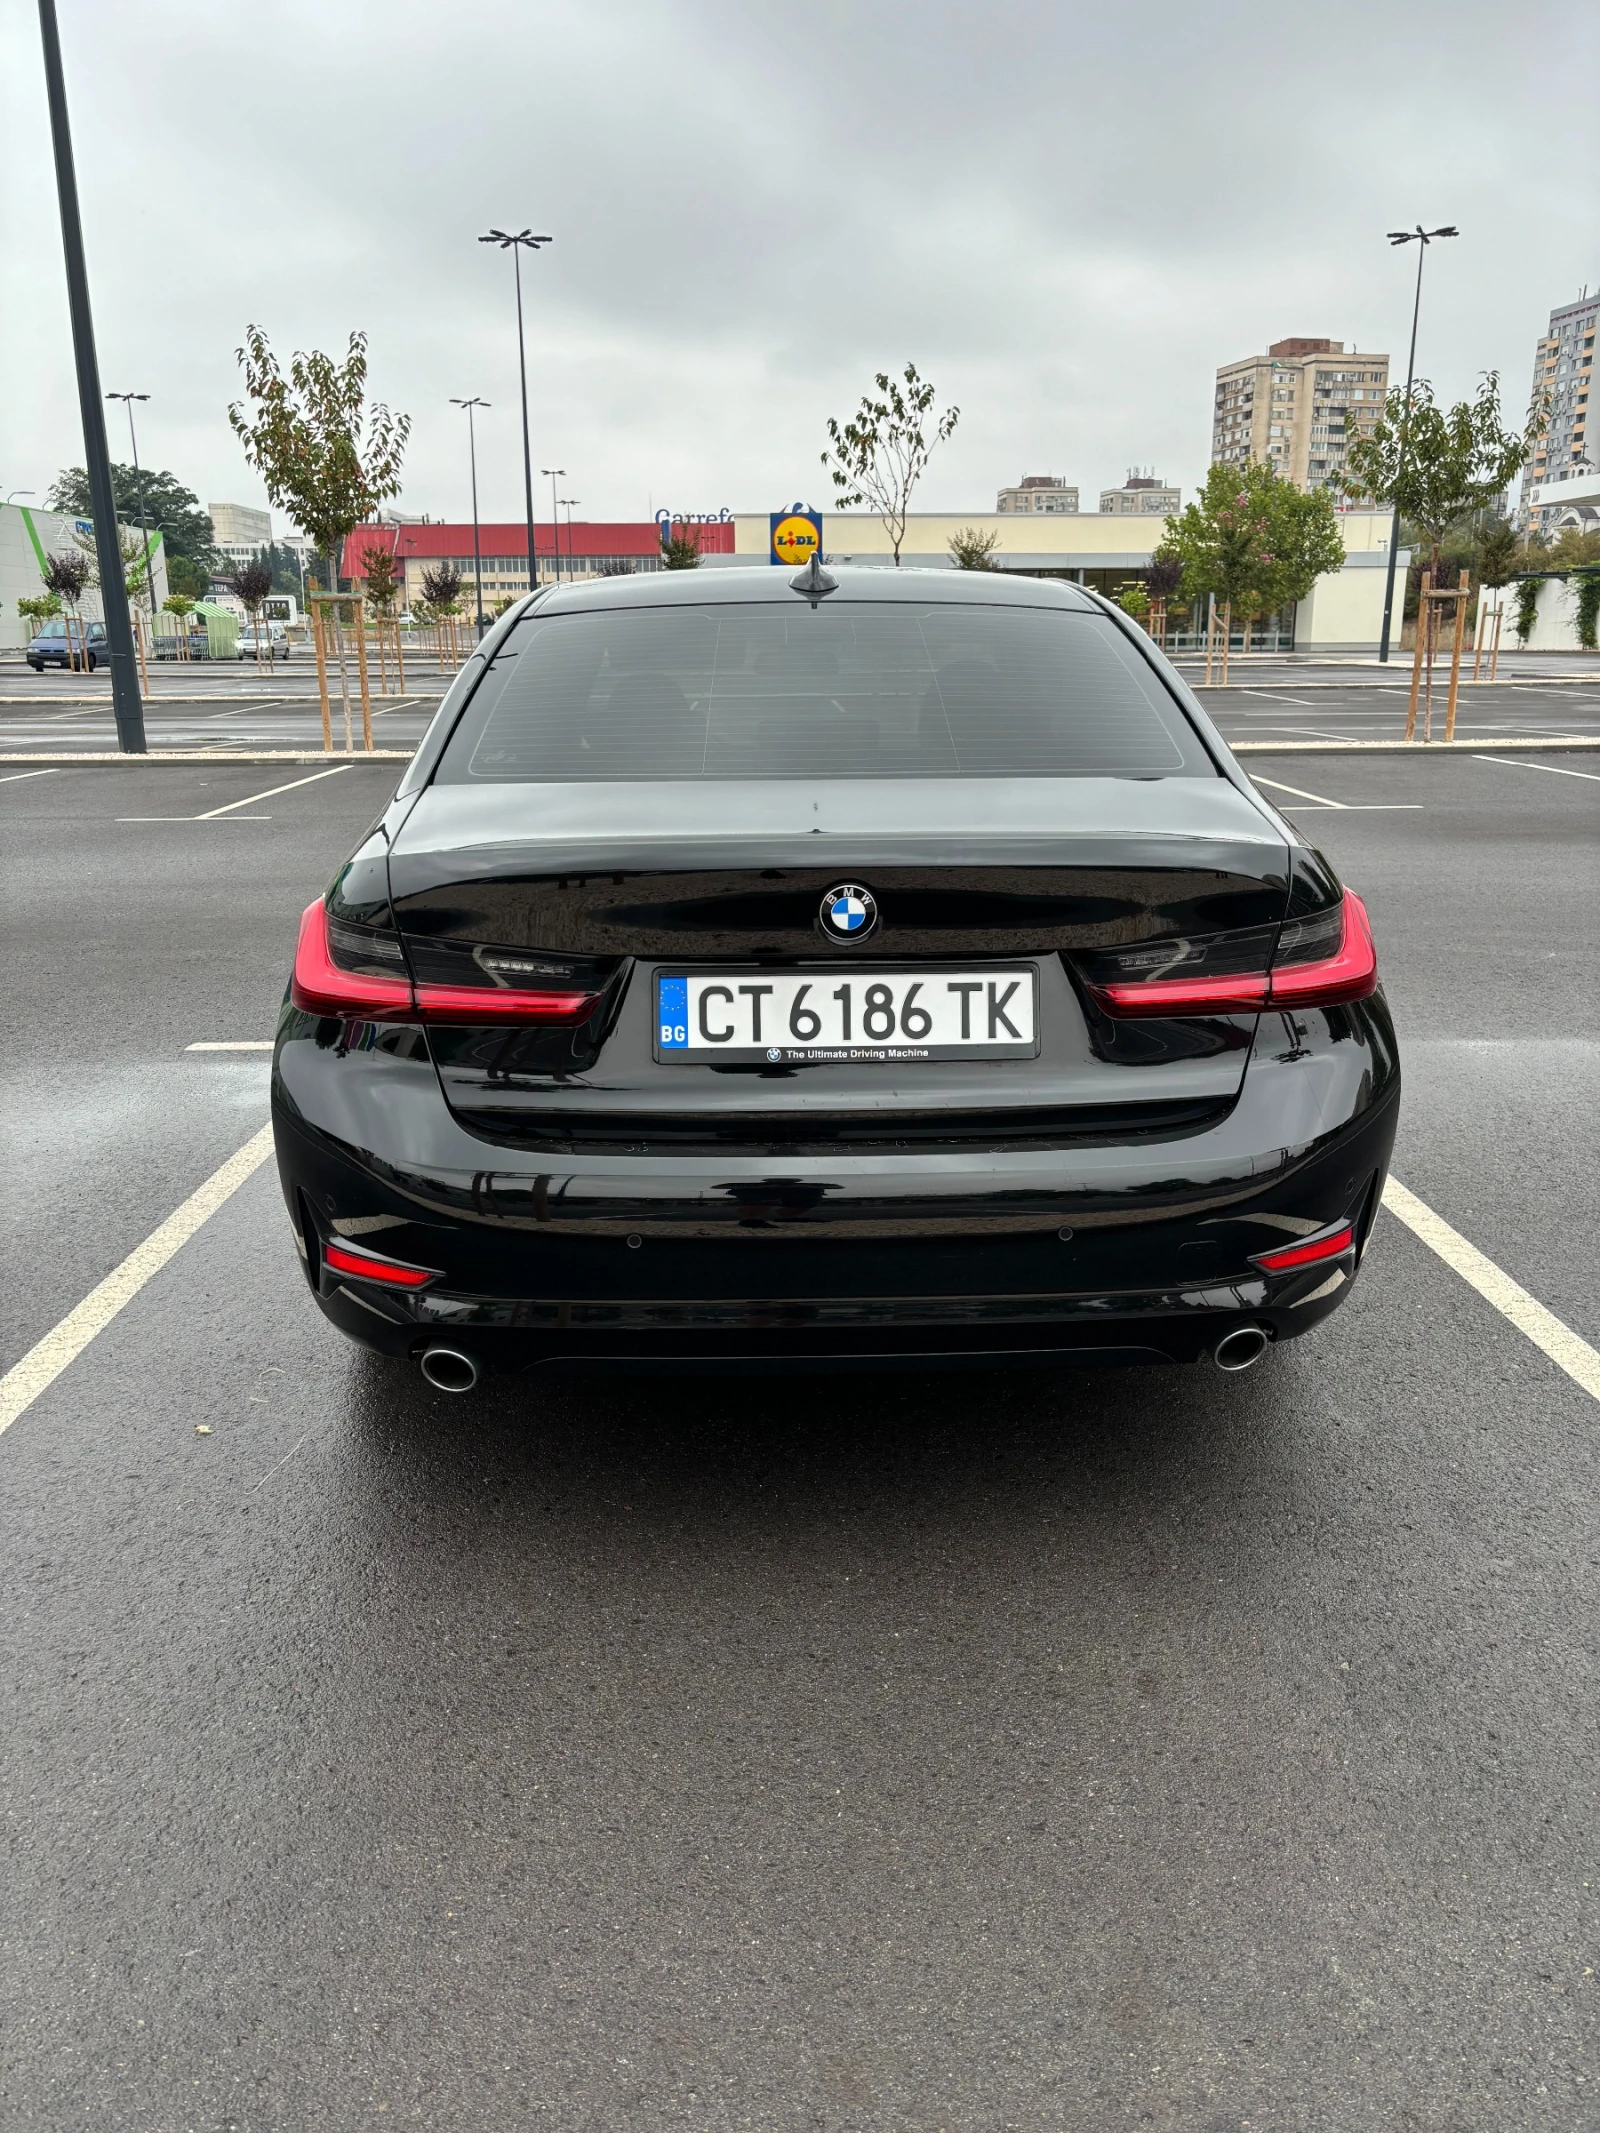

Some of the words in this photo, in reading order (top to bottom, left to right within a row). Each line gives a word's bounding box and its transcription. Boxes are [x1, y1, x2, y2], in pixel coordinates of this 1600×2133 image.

[826, 887, 872, 905] BMW
[699, 985, 773, 1042] CT
[789, 982, 932, 1041] 6186
[947, 981, 1023, 1039] TK
[661, 1026, 686, 1042] BG
[786, 1050, 805, 1059] The
[807, 1050, 848, 1059] Ultimate
[850, 1050, 886, 1059] Driving
[888, 1048, 929, 1058] Machine
